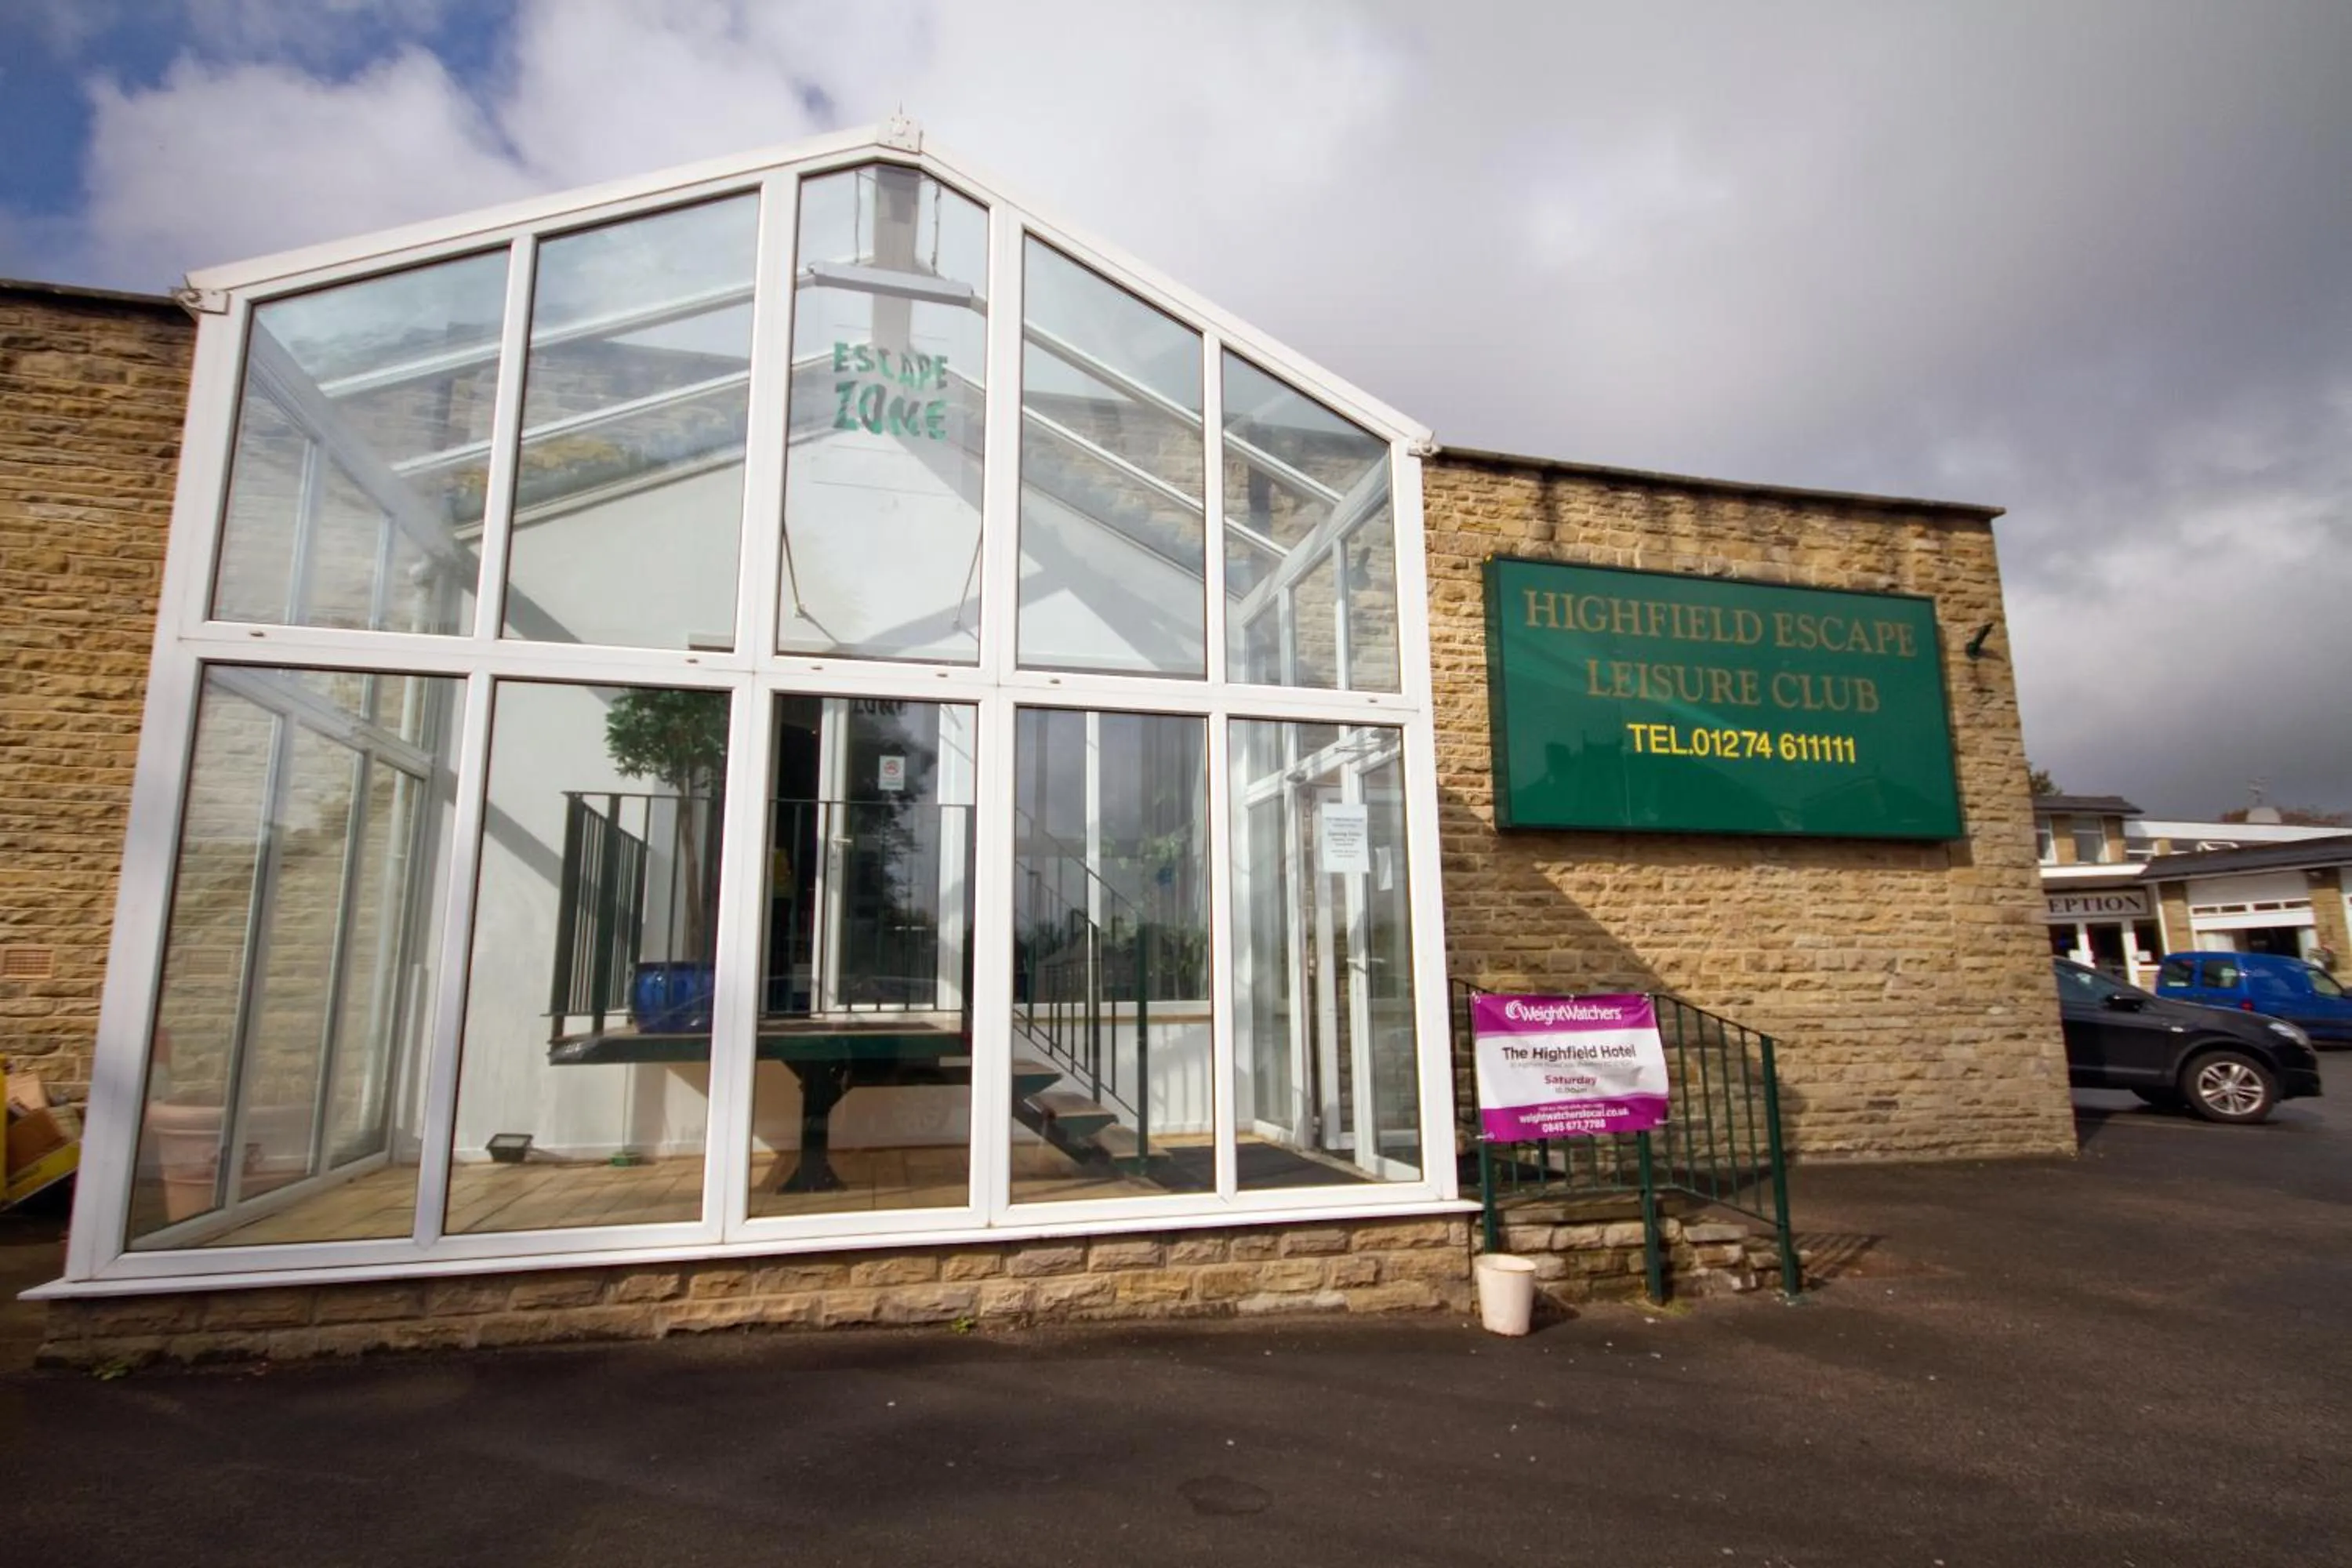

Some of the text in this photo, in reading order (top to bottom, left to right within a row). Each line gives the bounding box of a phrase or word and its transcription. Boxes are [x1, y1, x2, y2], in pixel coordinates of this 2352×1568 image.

[833, 341, 949, 390] ESCAPE
[833, 380, 948, 441] ZONE
[1523, 590, 1918, 657] HIGHFIELD ESCAPE
[1586, 659, 1881, 713] LEISURE CLUB
[1627, 724, 1857, 764] TEL.01274 611111
[1516, 1004, 1622, 1025] WeightWatchers
[1502, 1044, 1637, 1062] The Highfield Hotel
[1544, 1075, 1597, 1086] Saturday
